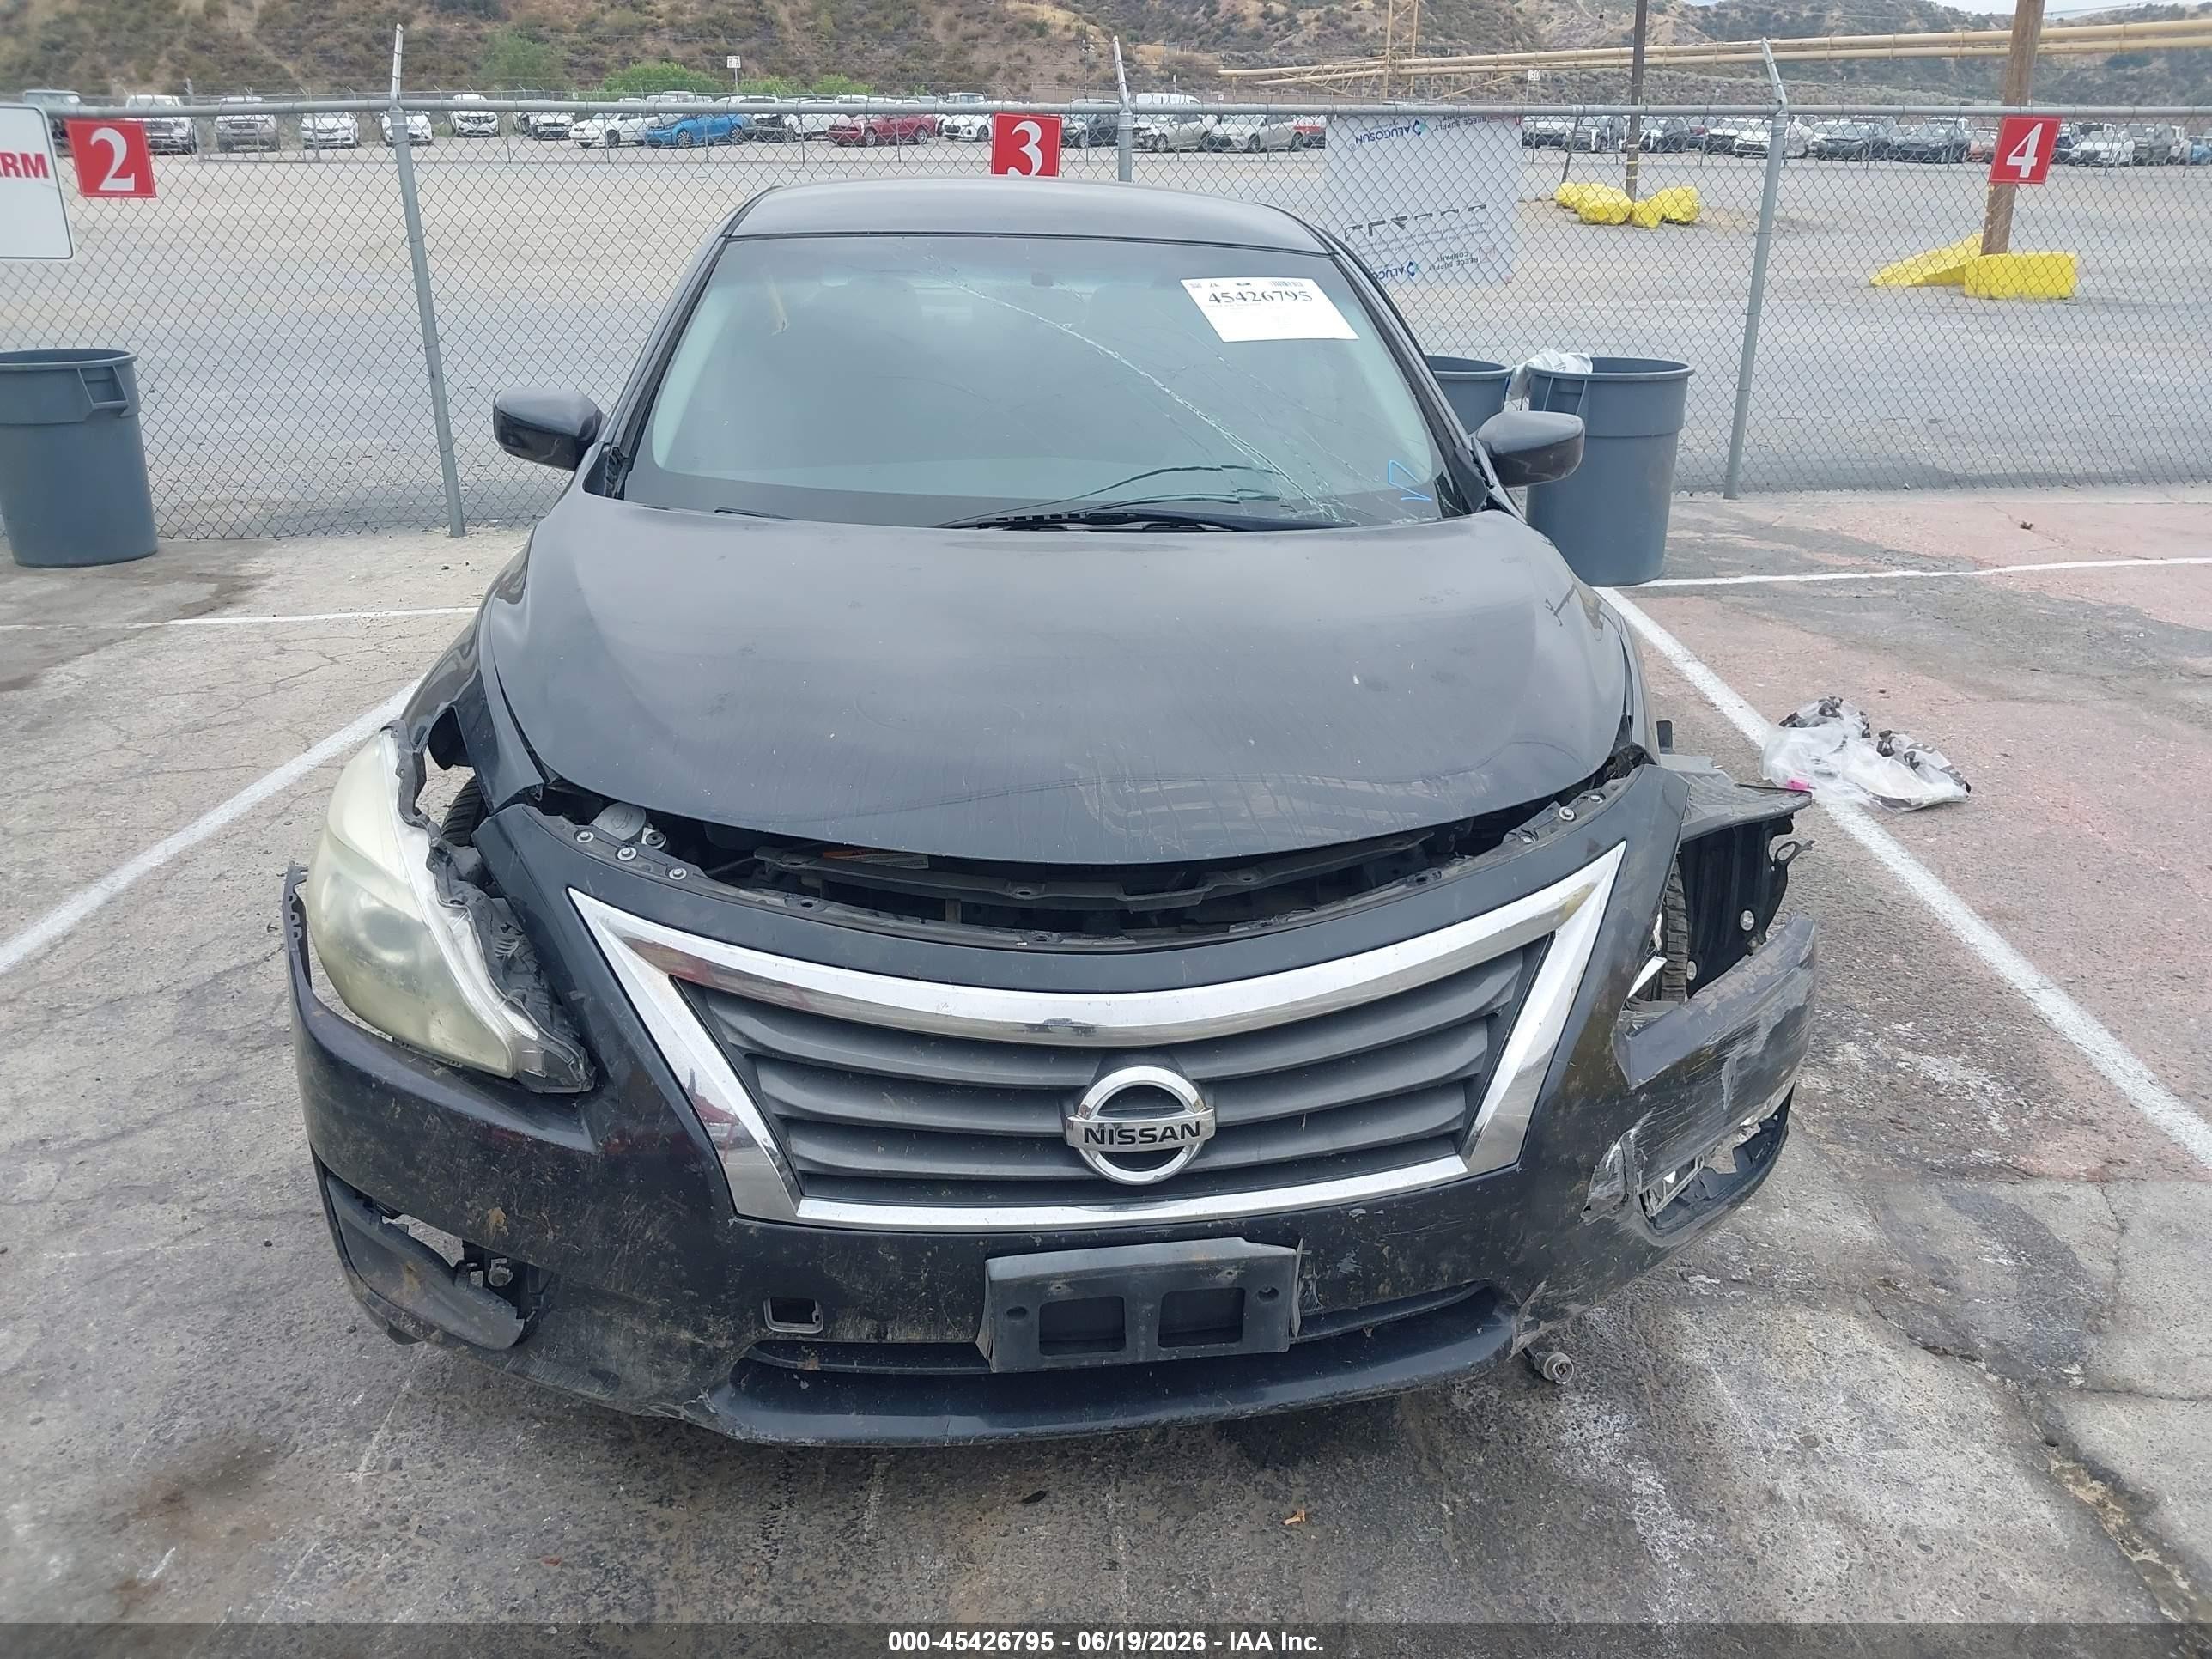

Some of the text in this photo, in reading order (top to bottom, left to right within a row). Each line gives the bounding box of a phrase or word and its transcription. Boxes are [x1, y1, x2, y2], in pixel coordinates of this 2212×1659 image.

[0, 152, 50, 179] RM
[90, 127, 136, 191] 2
[1007, 120, 1043, 176] 3
[2006, 123, 2043, 178] 4
[1208, 290, 1313, 304] 45426795
[1084, 1121, 1200, 1145] NISSAN
